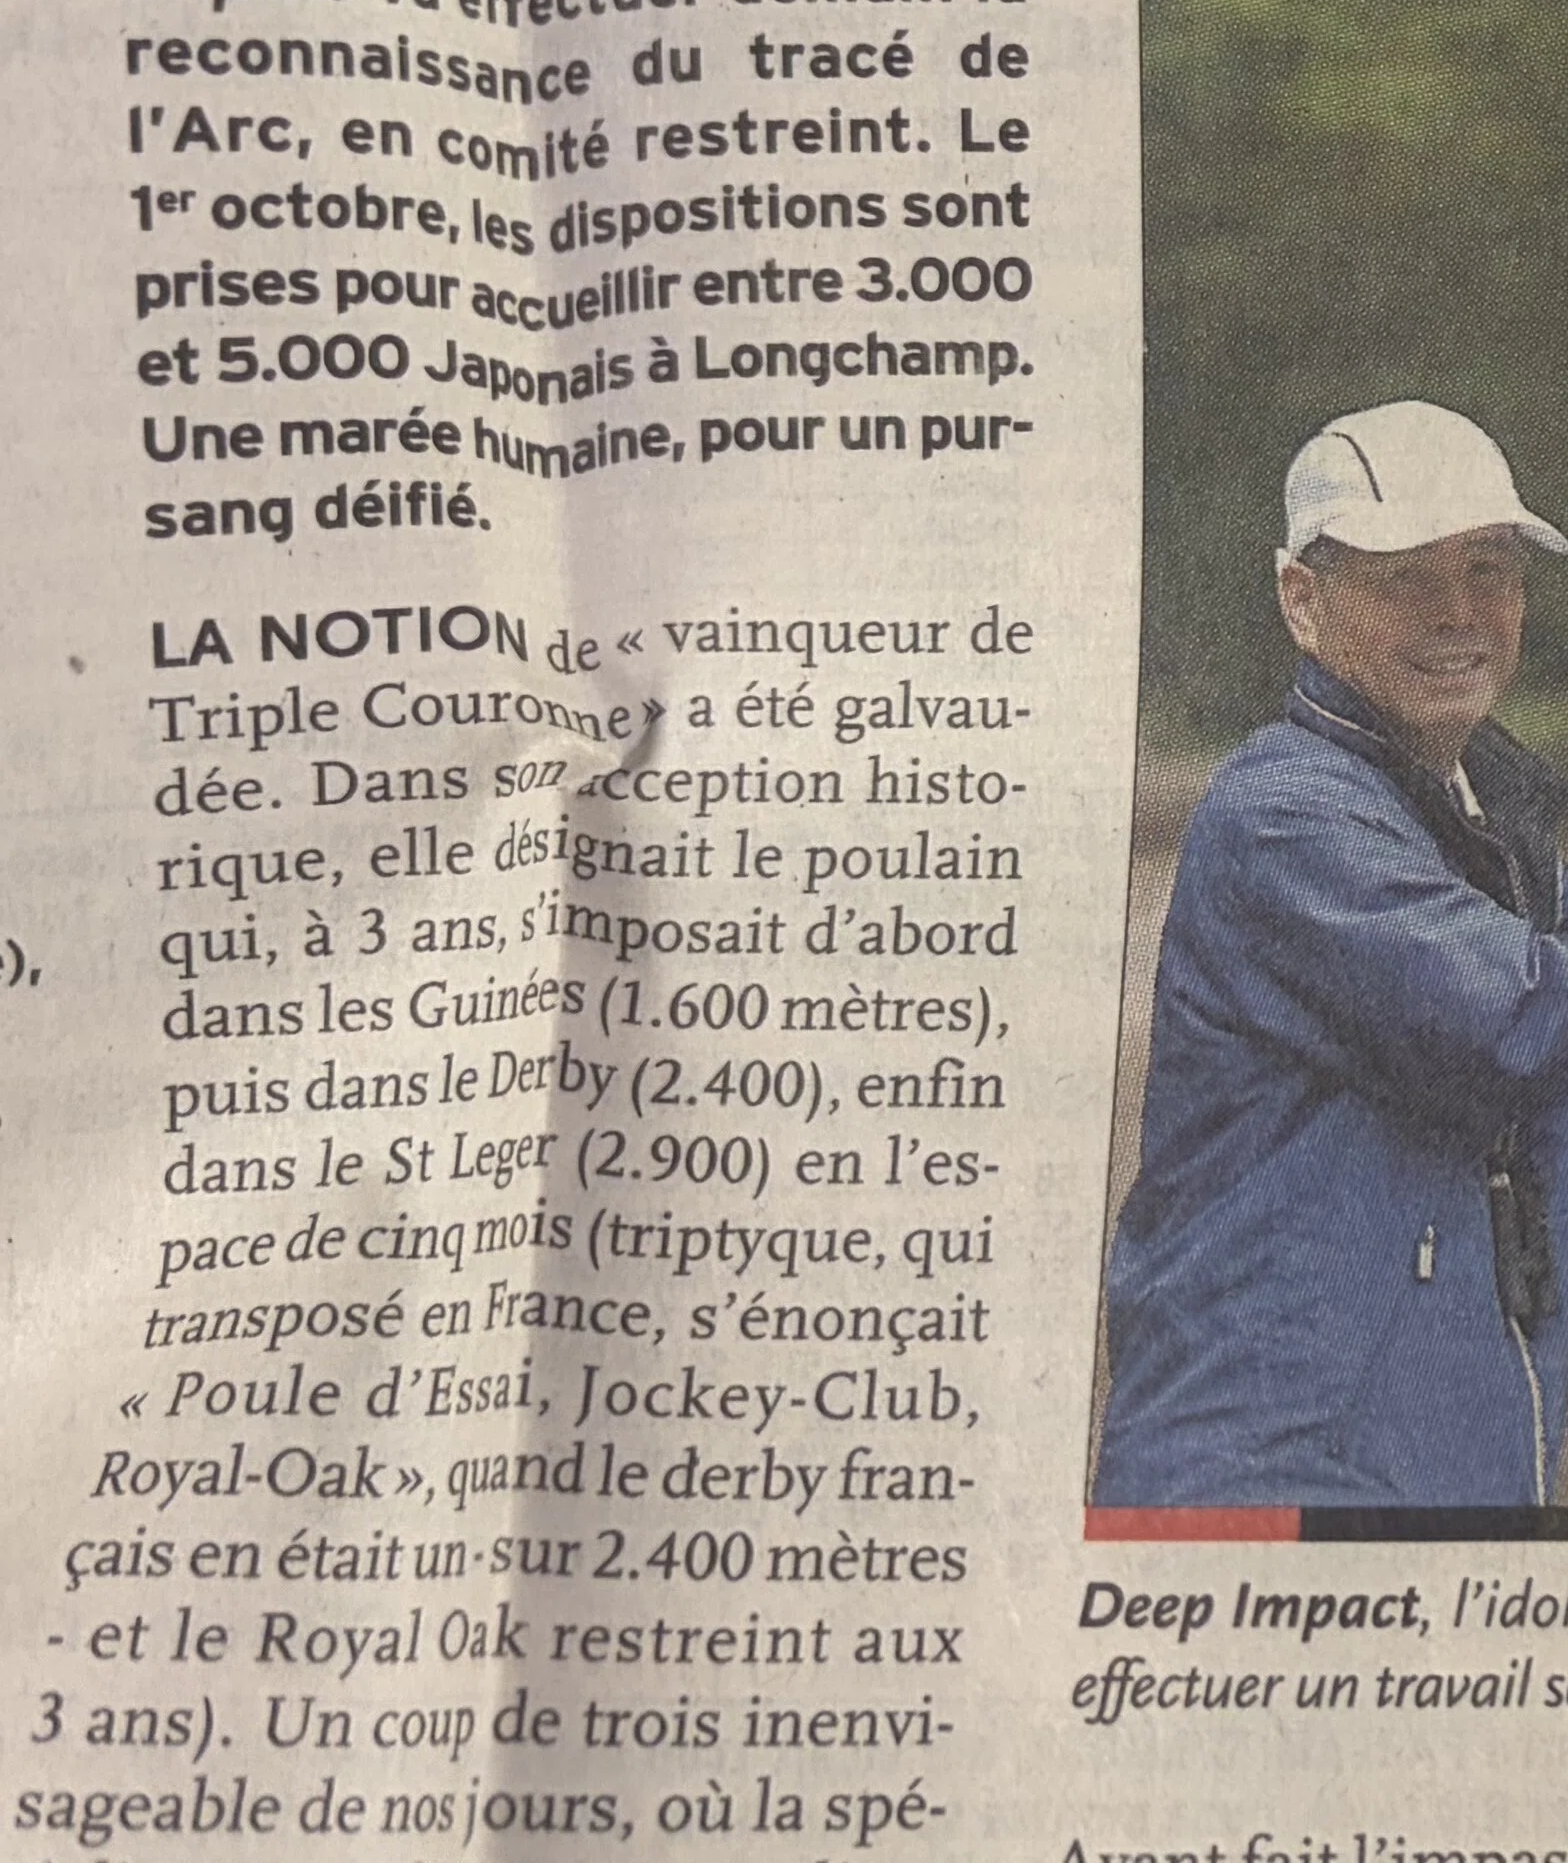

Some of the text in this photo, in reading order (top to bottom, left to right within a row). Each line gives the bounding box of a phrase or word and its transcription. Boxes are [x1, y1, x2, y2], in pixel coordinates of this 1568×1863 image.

[125, 28, 1029, 106] reconnaissance du tracé de
[128, 105, 1030, 182] l'Arc, en comité restreint. Le
[129, 181, 1030, 256] 1er octobre, les dispositions sont
[135, 255, 1033, 332] prises pour accueillir entre 3.000
[137, 330, 1034, 407] et 5.000 Japonais à Longchamp.
[142, 405, 1034, 480] Une marée humaine, pour un pur-
[144, 478, 491, 544] sang déifié.
[162, 975, 1009, 1048] dans les Guinées (1.600 mètres),
[164, 1362, 341, 1418] Poule
[365, 1356, 551, 1419] d'Essai,
[573, 1364, 979, 1436] Jockey-Club,
[1078, 1581, 1214, 1644] Deep
[1231, 1582, 1430, 1644] Impact,
[1071, 1655, 1285, 1726] effectuer
[1295, 1674, 1359, 1709] un
[1375, 1656, 1534, 1710] travail
